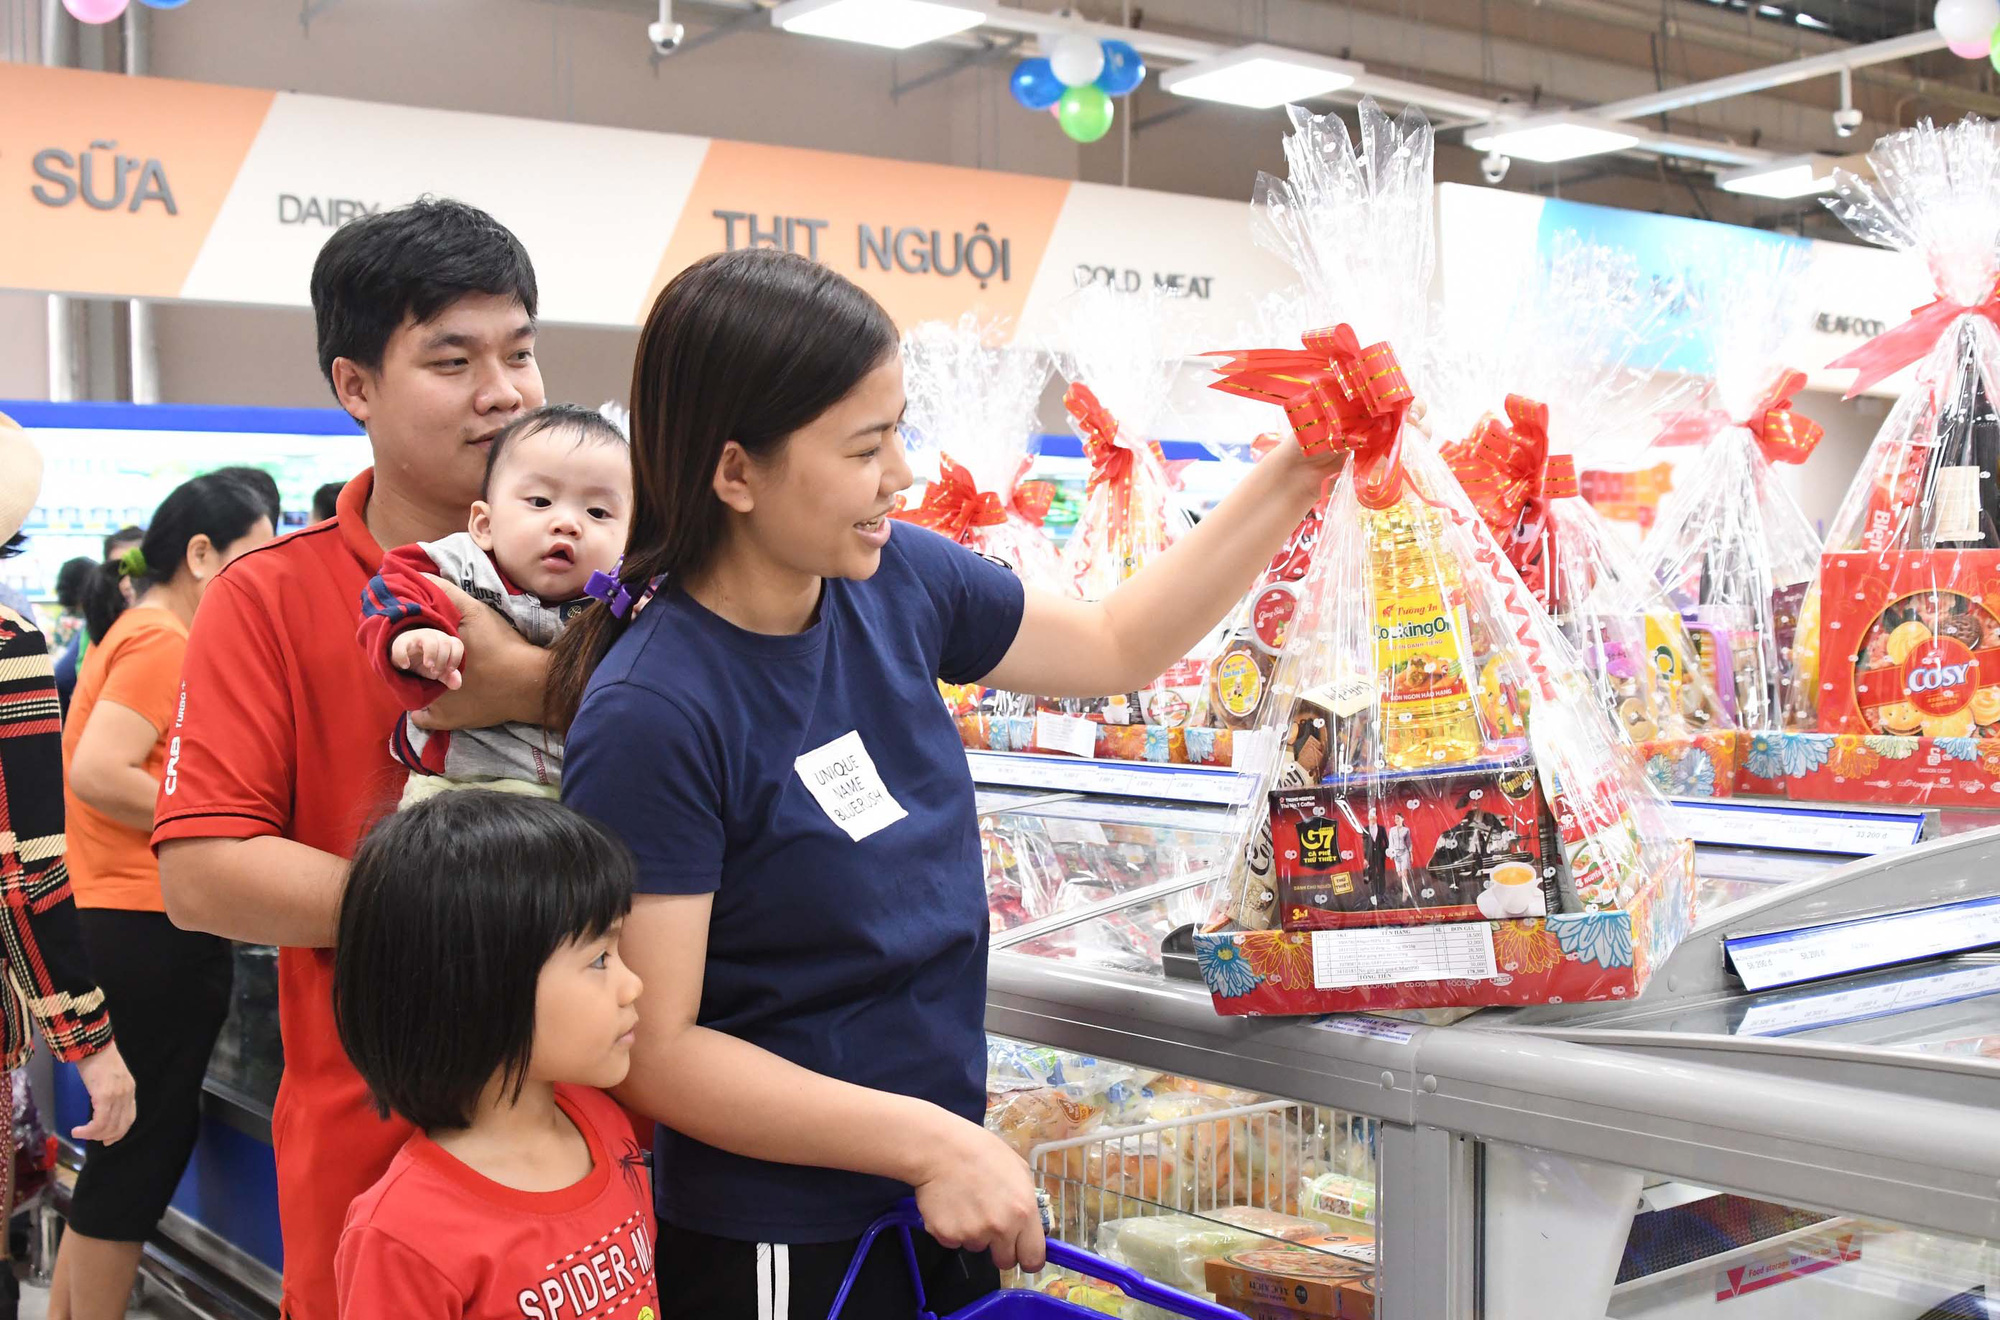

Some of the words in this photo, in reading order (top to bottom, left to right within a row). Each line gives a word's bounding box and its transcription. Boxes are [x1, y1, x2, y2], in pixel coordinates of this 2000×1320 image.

[31, 138, 179, 216] SỮA
[858, 222, 1010, 289] NGUỘI
[1908, 663, 1970, 692] COSY
[165, 736, 181, 796] CRB
[814, 754, 860, 786] UNIQUE
[832, 776, 866, 800] NAME
[834, 789, 886, 821] BLUERUSH
[517, 1222, 653, 1320] SPIDER-M
